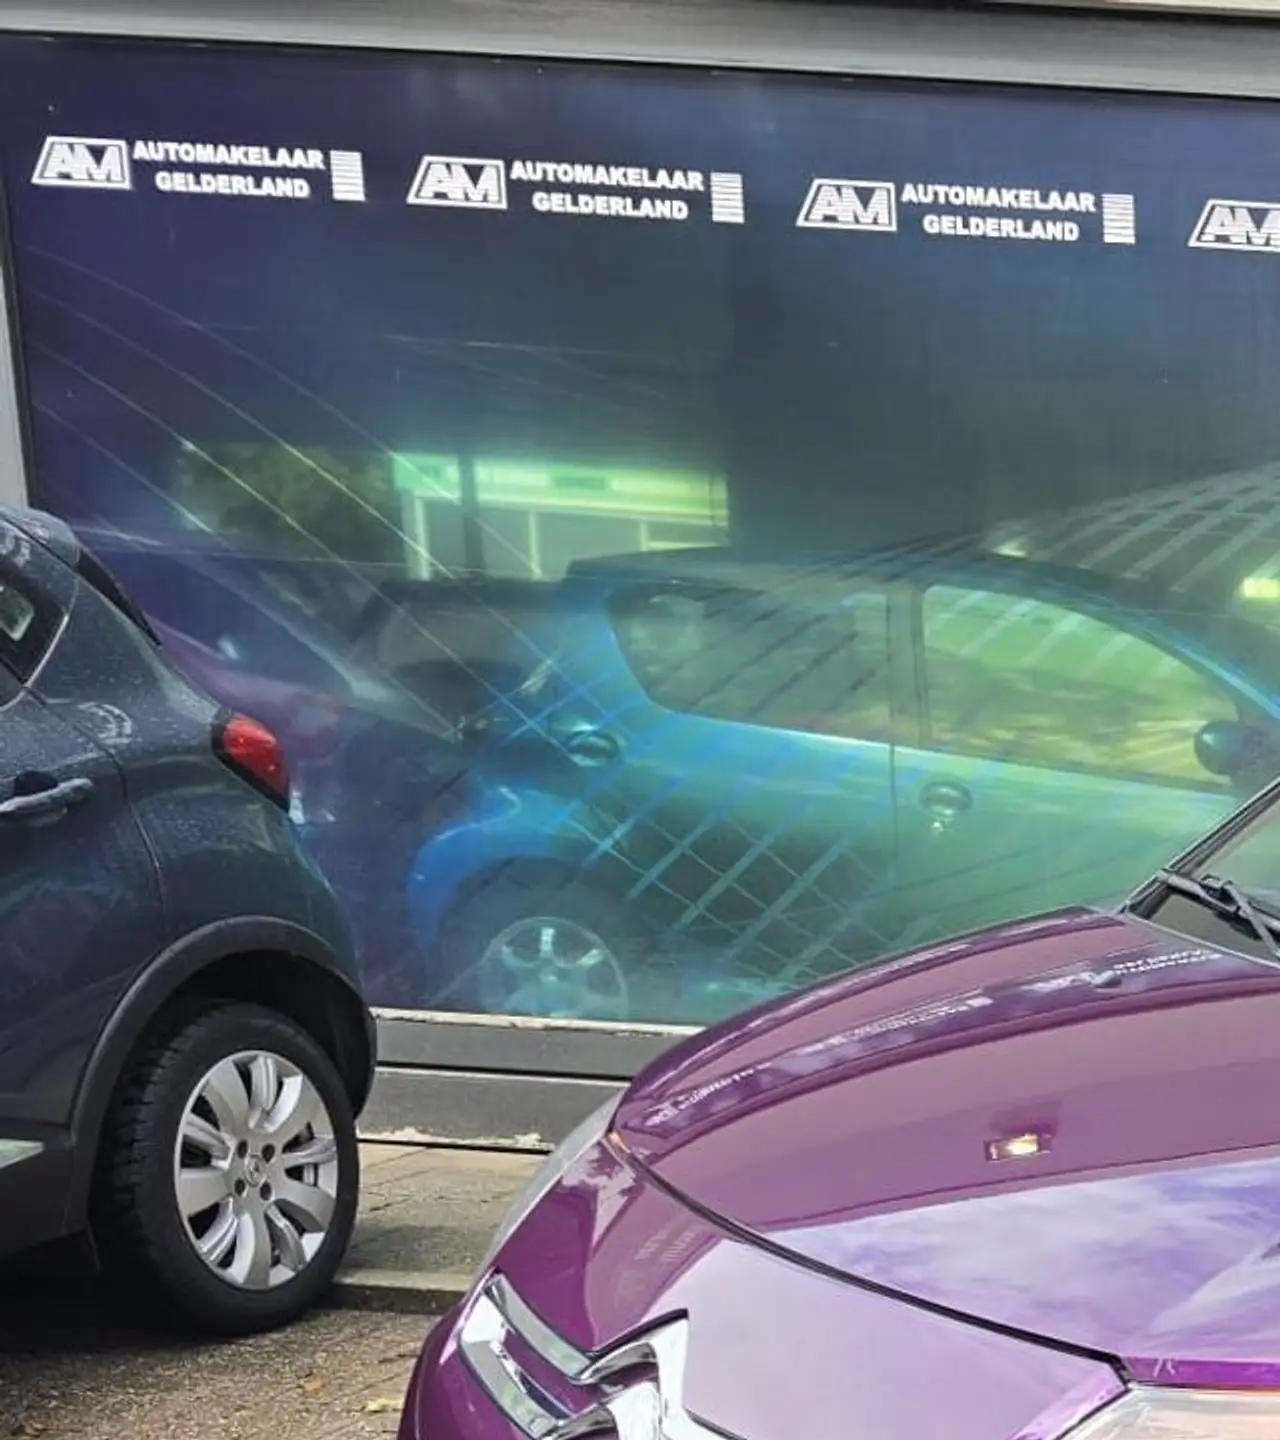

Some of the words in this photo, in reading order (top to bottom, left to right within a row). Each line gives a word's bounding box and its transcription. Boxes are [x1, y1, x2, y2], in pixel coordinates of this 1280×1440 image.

[42, 143, 125, 182] AM
[132, 140, 325, 169] AUTOMAKELAAR
[156, 171, 309, 198] GELDERLAND
[416, 162, 500, 203] AM
[510, 159, 704, 191] AUTOMAKELAAR
[532, 192, 688, 220] GELDERLAND
[807, 186, 889, 225] AM
[901, 183, 1095, 213] AUTOMAKELAAR
[923, 214, 1079, 242] GELDERLAND
